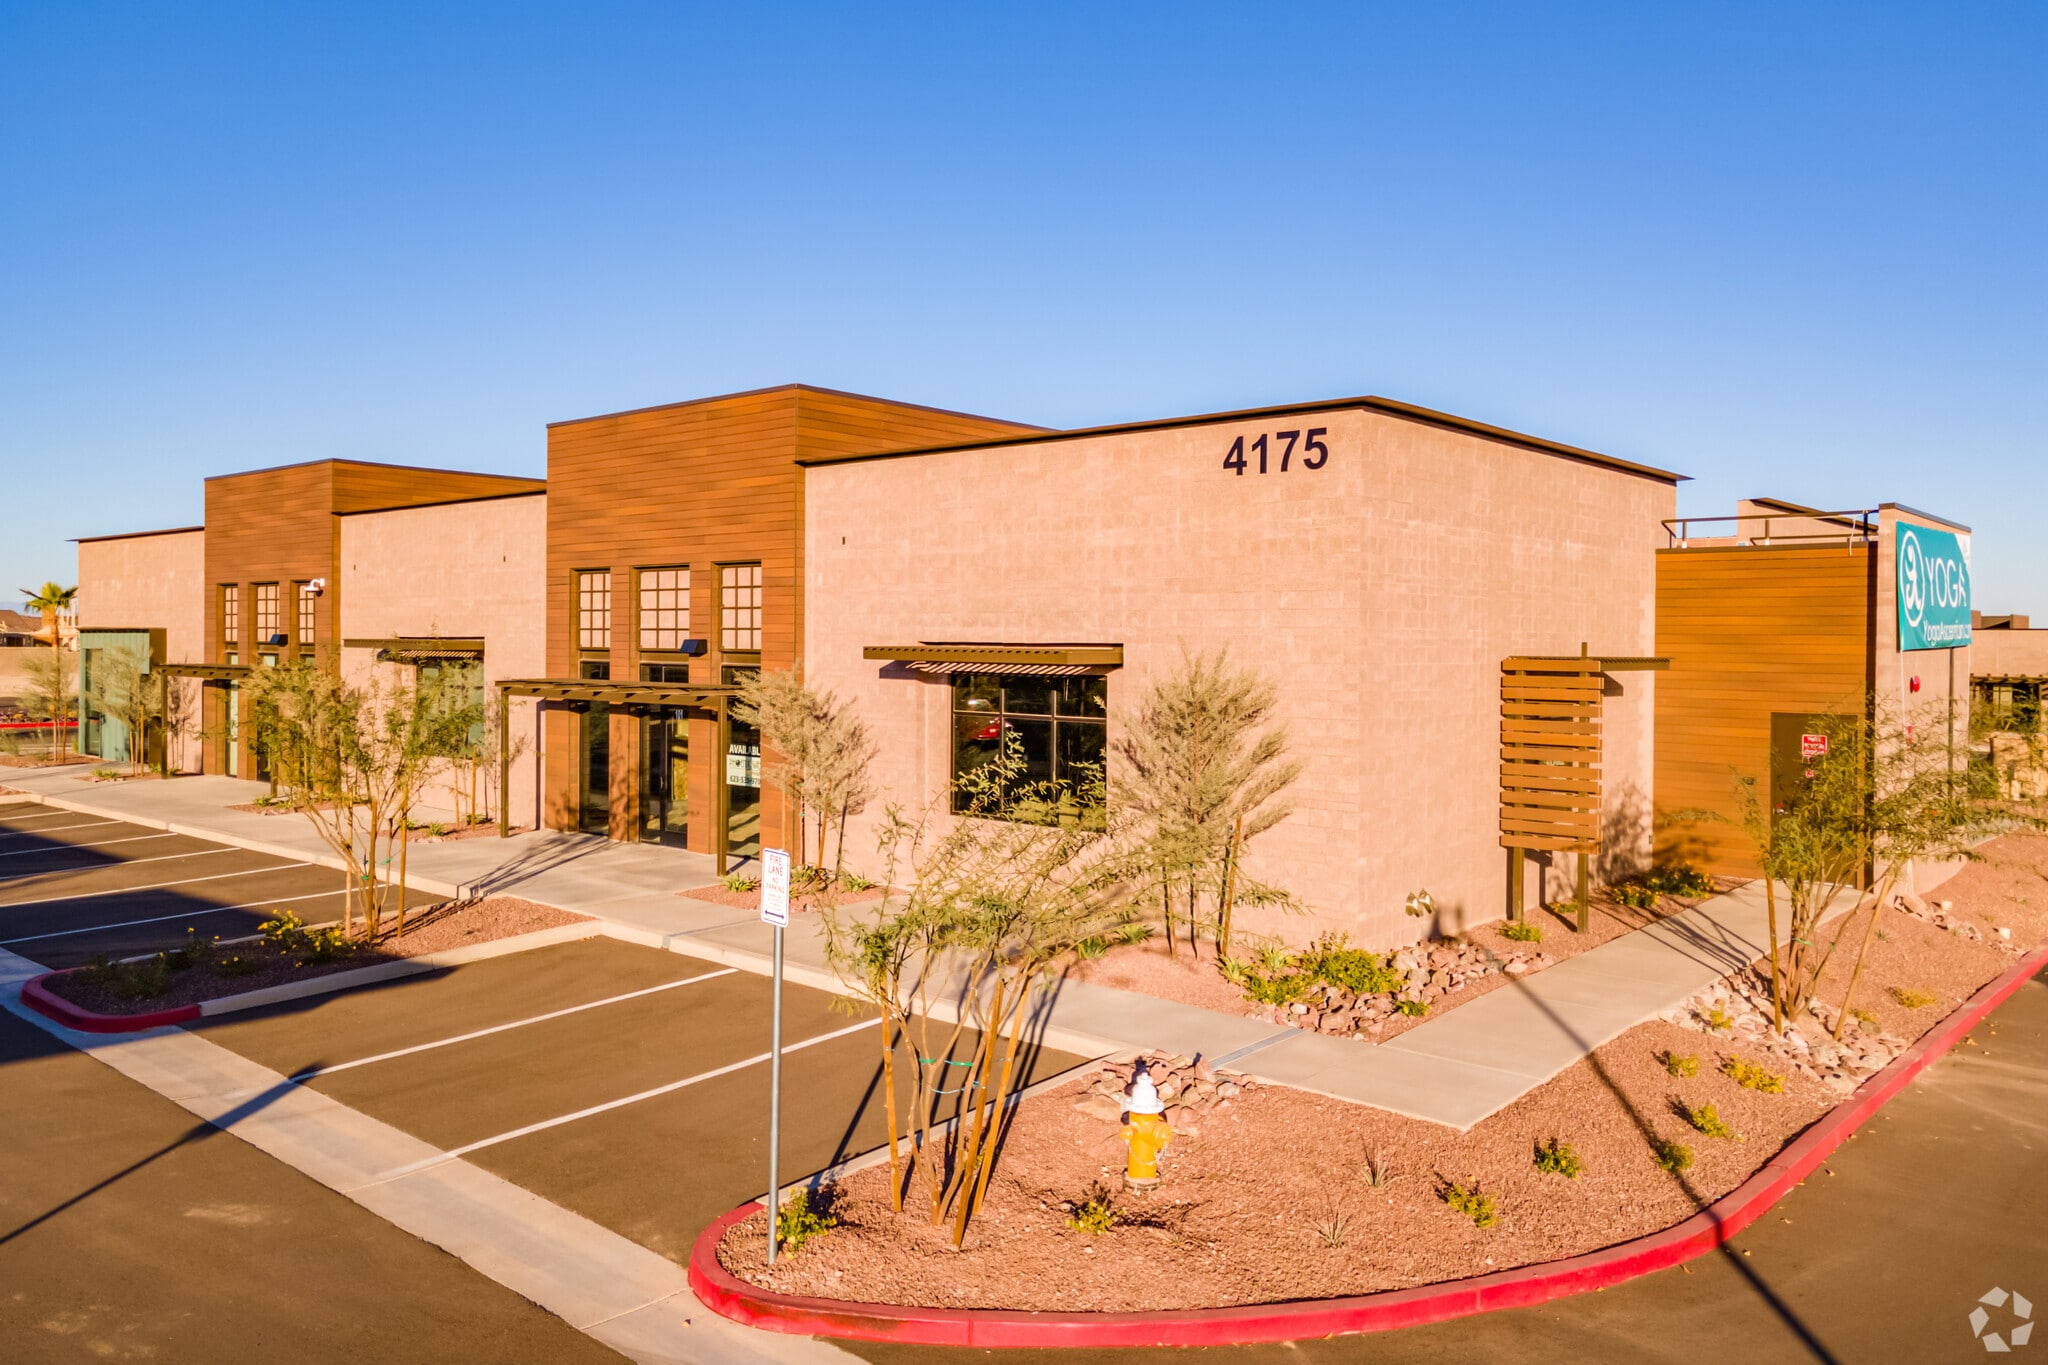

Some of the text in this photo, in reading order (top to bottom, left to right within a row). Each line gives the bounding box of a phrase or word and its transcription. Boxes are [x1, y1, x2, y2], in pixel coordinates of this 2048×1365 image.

[1223, 427, 1329, 476] 4175
[1925, 556, 1967, 608] YOGA
[729, 744, 761, 756] AVAILABL
[770, 855, 783, 866] FIRE
[768, 865, 783, 876] LANE
